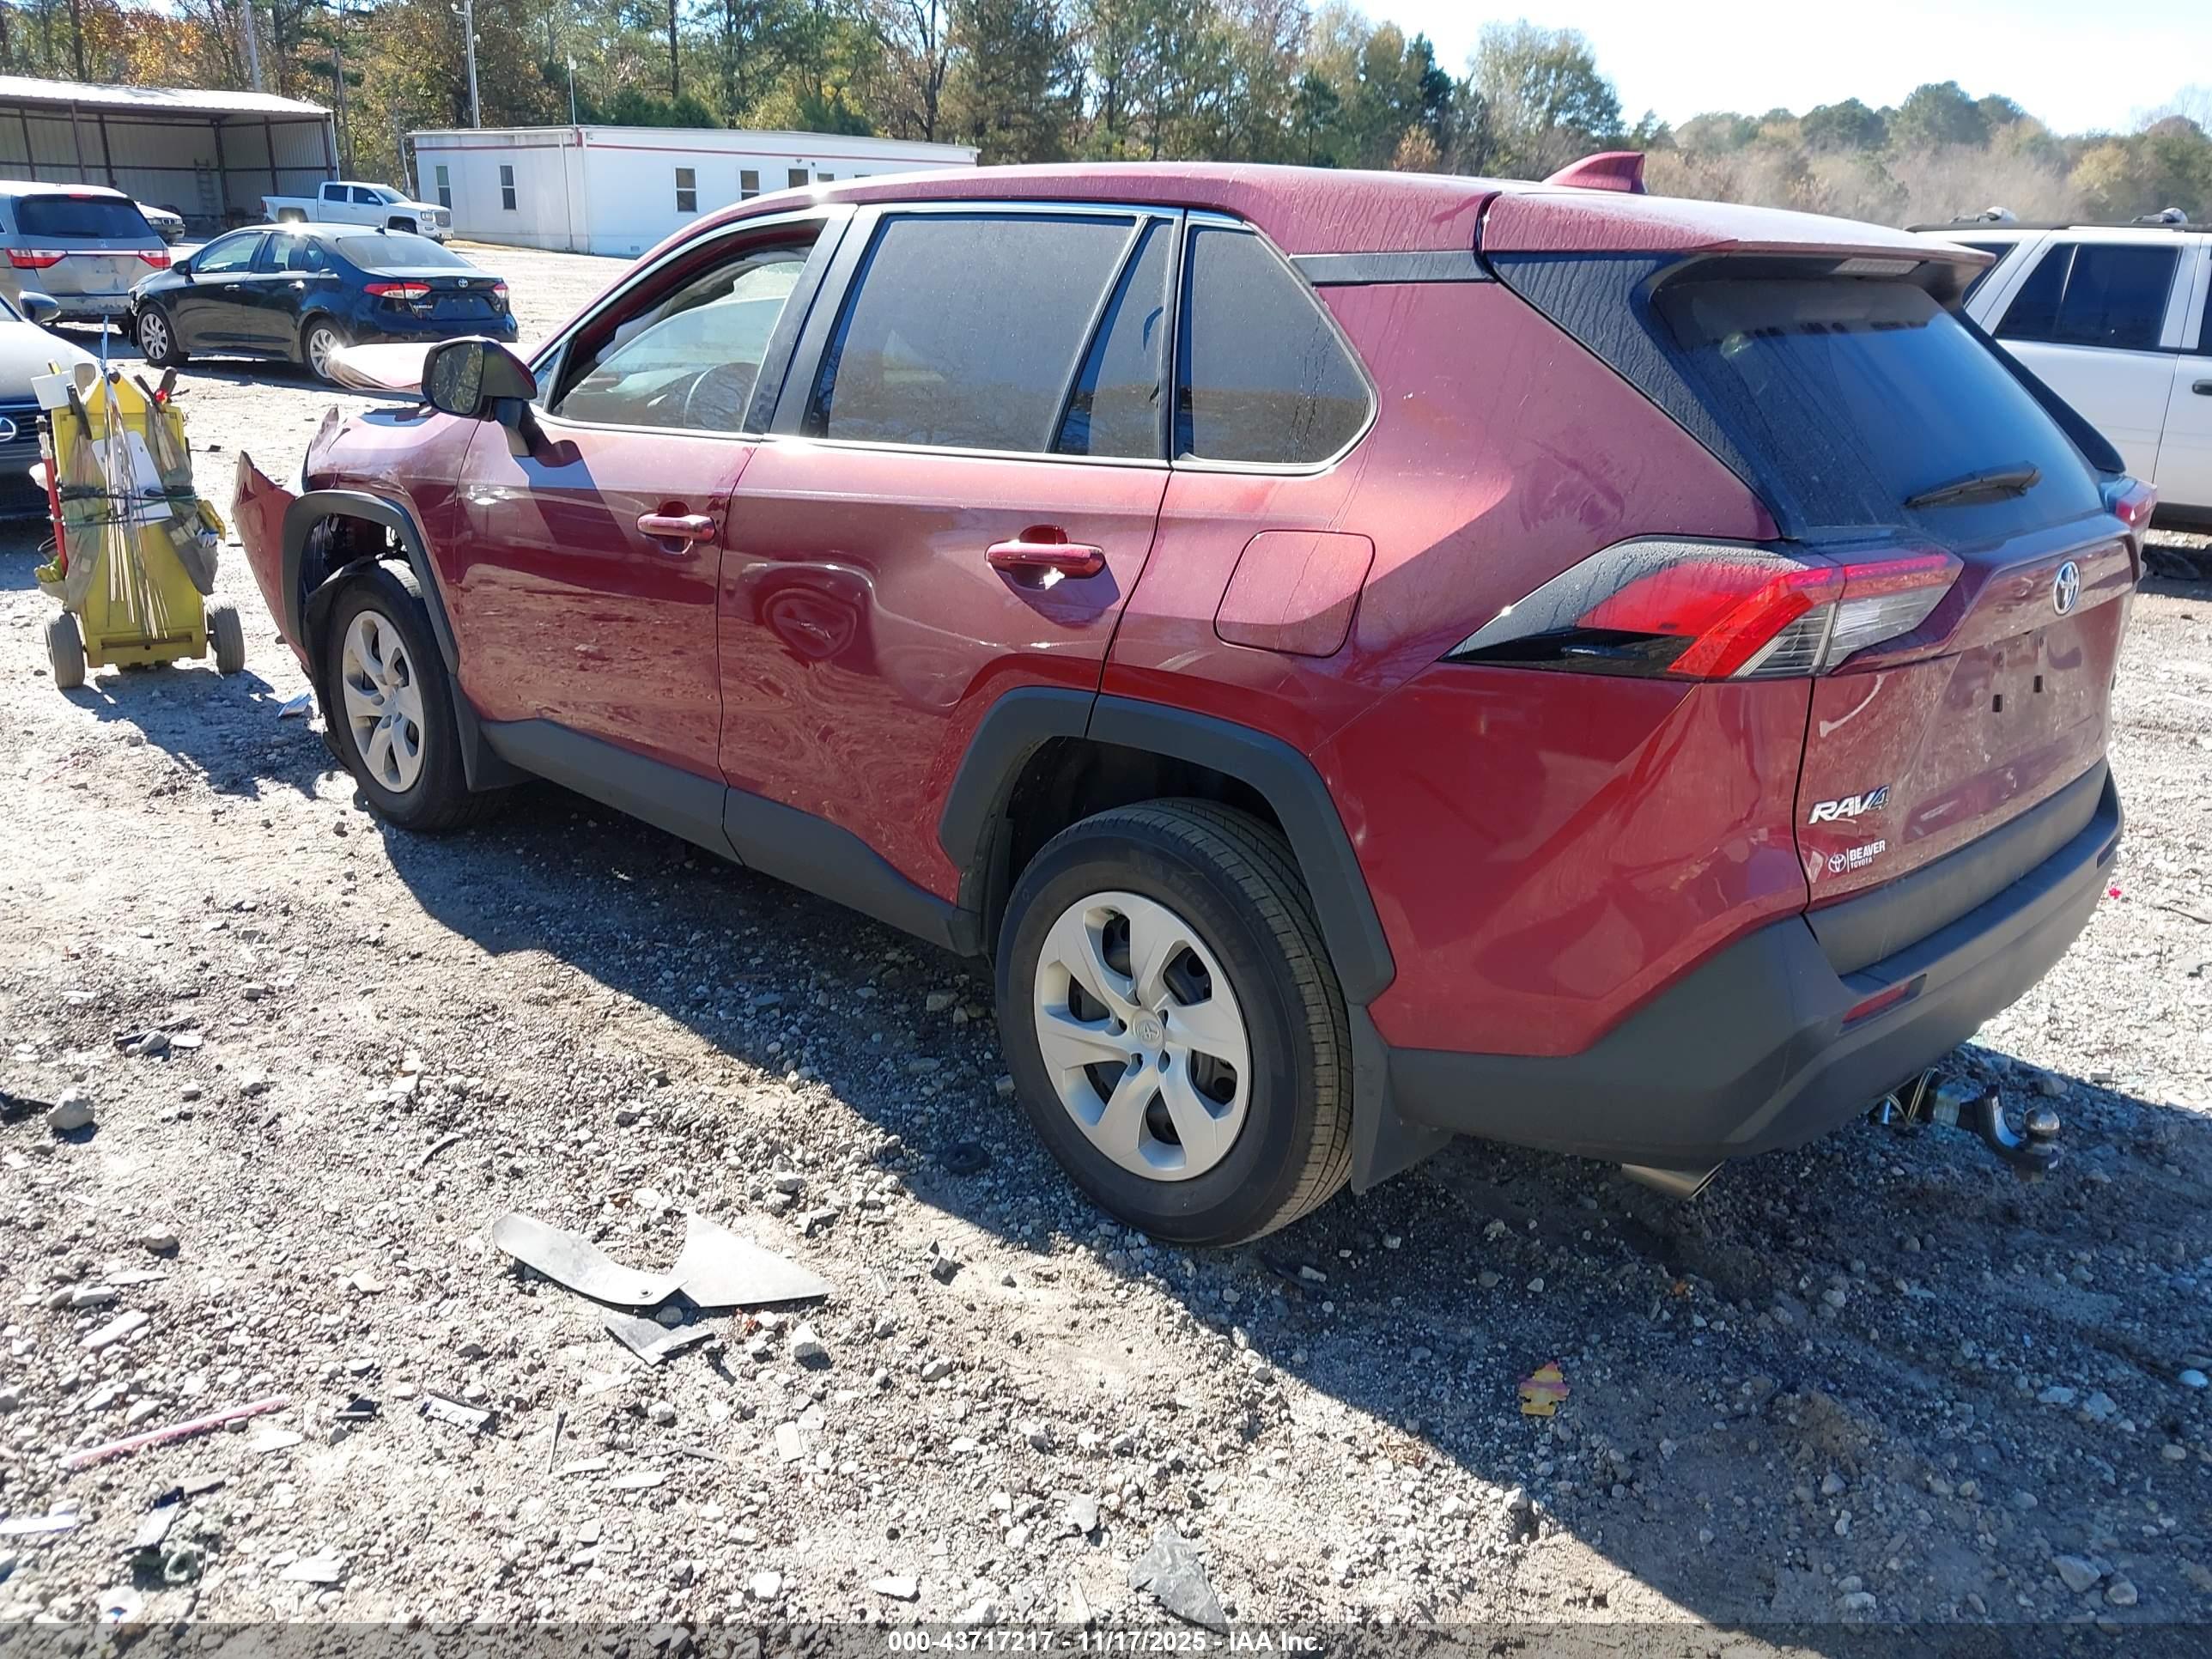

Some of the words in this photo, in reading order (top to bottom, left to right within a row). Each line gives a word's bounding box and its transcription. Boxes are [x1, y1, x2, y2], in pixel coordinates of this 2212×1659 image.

[1808, 785, 1890, 824] RAV4
[1849, 840, 1886, 862] BEAVER
[1850, 857, 1873, 869] TOYOTA
